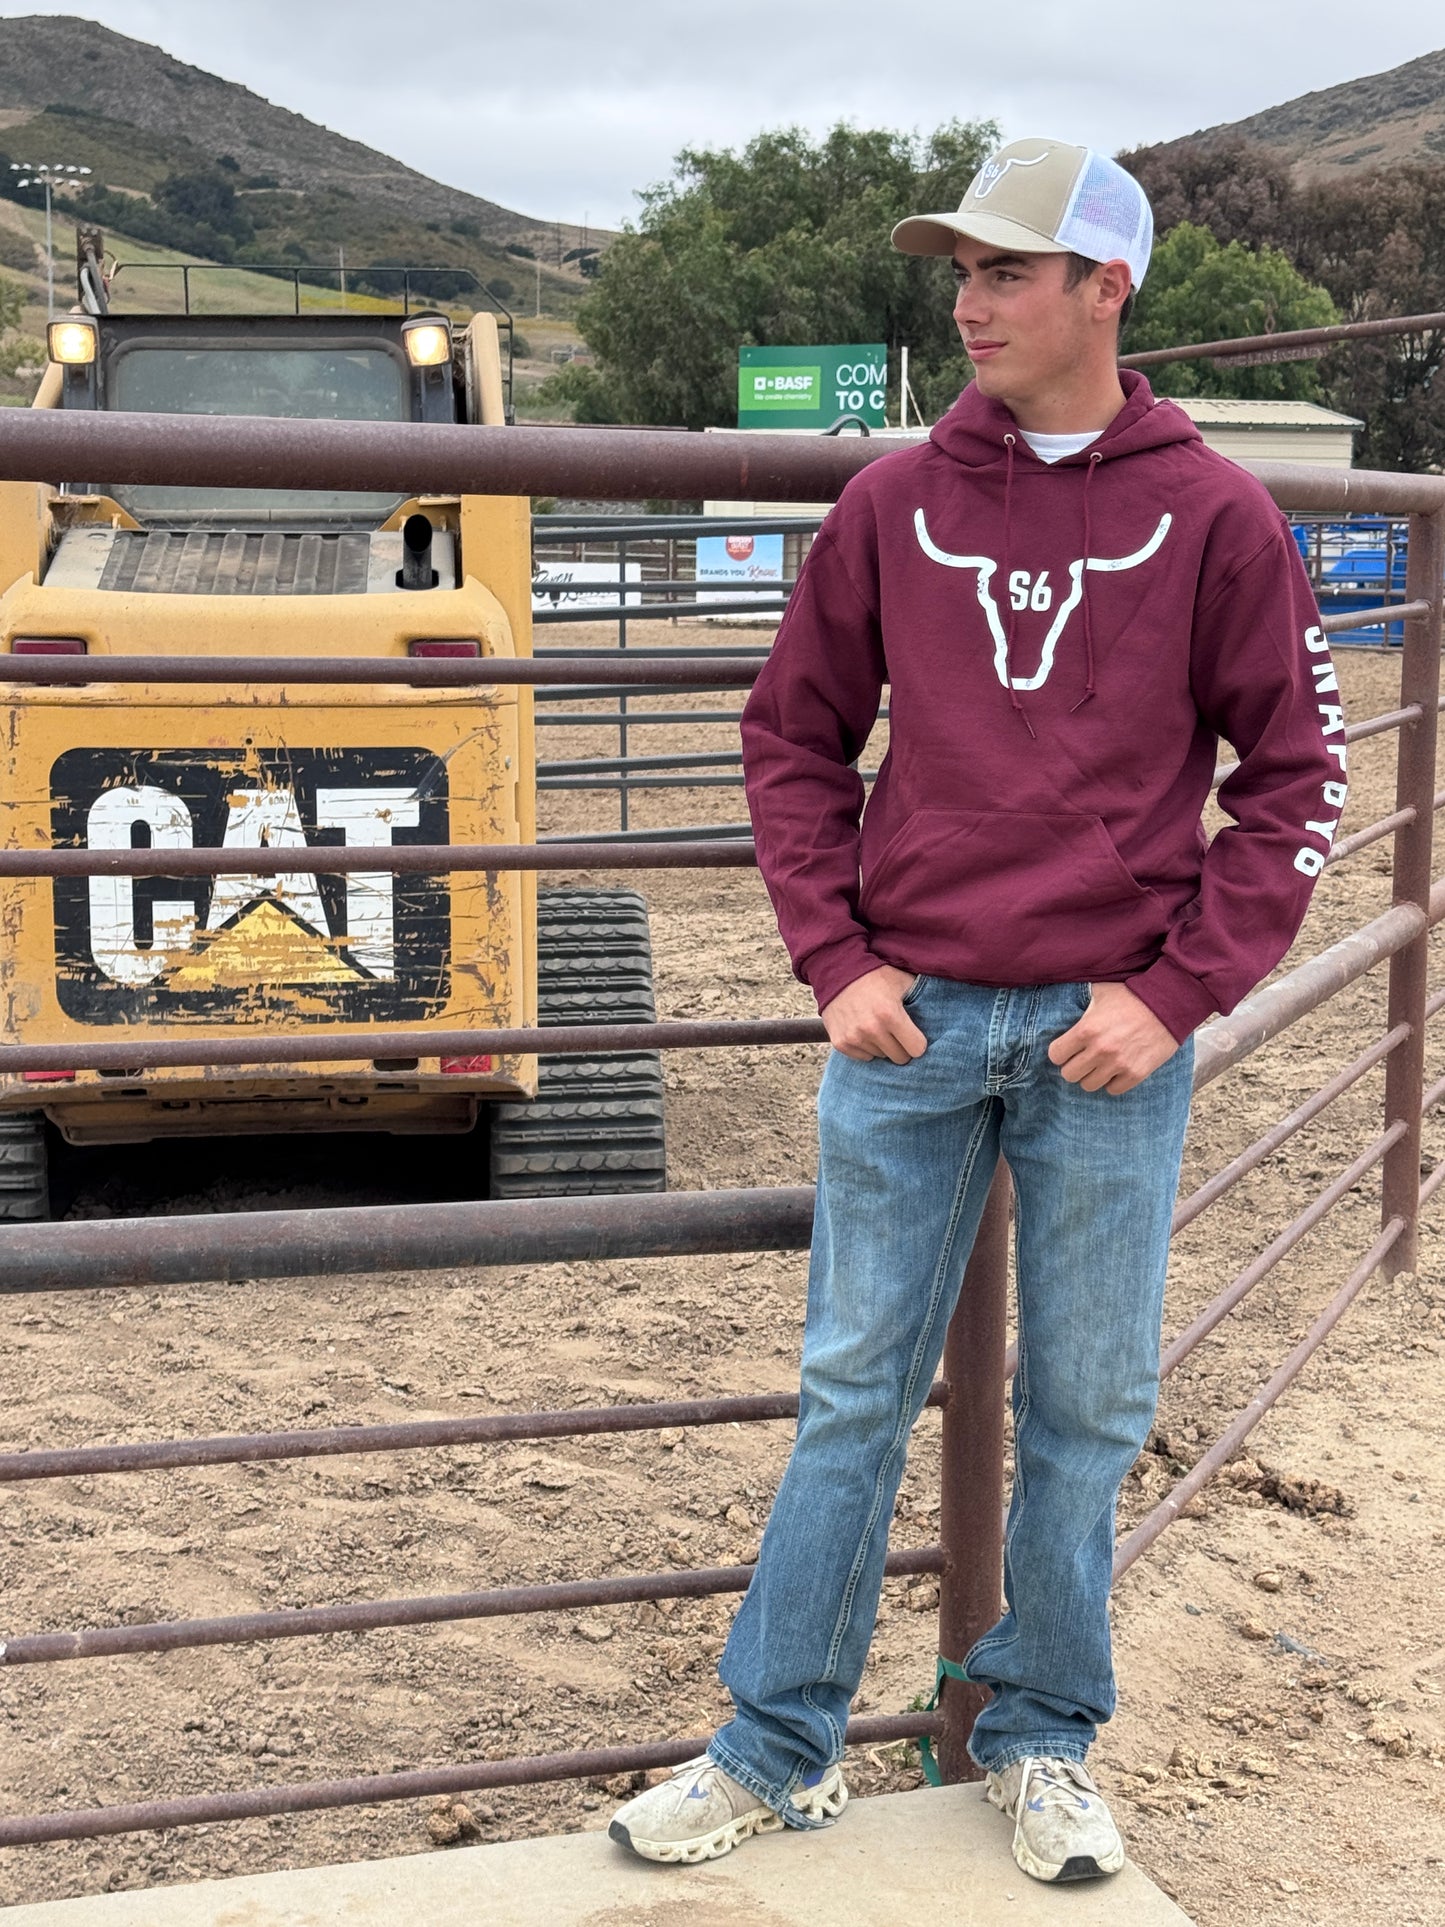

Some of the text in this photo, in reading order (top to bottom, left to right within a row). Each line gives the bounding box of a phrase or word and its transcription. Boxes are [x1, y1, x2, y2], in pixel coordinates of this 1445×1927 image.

[985, 164, 999, 178] S6
[774, 376, 814, 390] BASF
[835, 390, 864, 411] TO
[730, 568, 746, 576] YOU
[1008, 570, 1052, 612] S6
[87, 785, 420, 985] CAT
